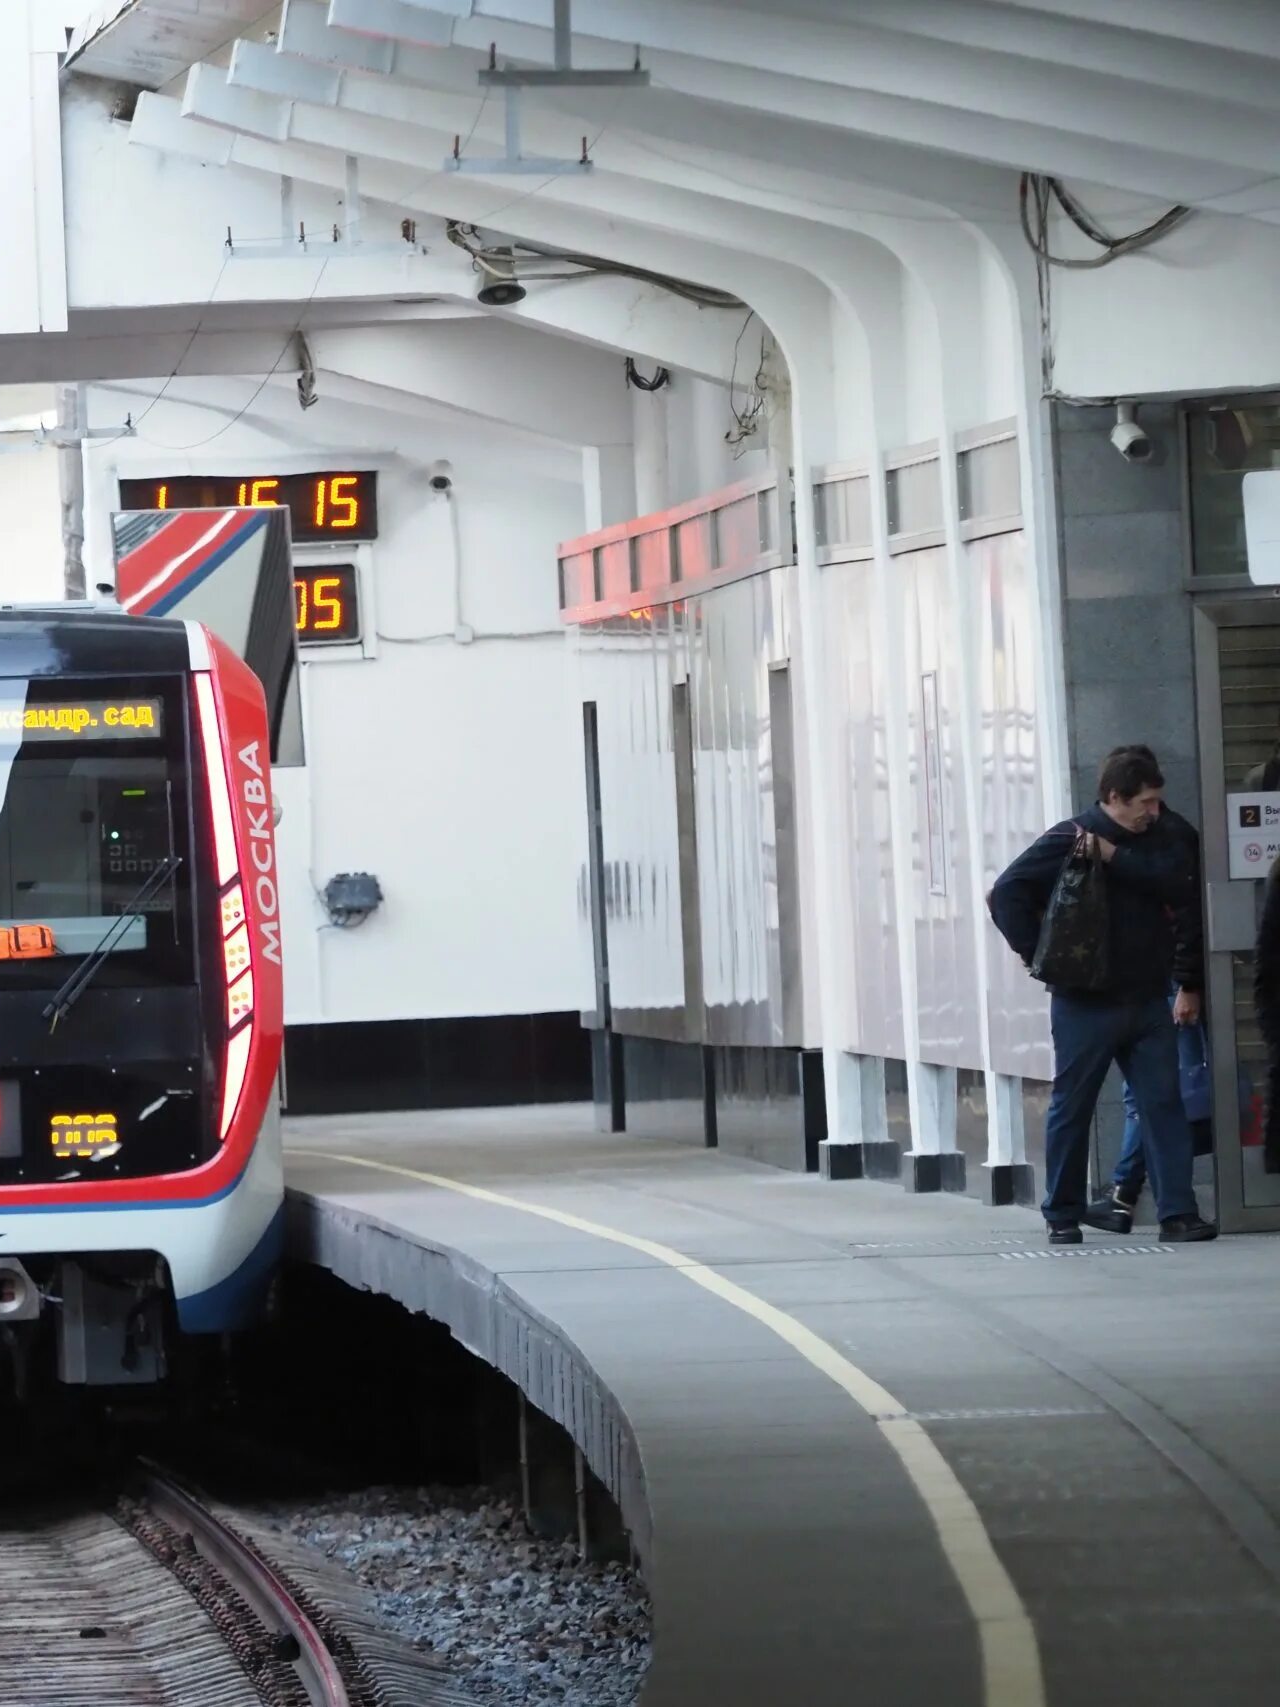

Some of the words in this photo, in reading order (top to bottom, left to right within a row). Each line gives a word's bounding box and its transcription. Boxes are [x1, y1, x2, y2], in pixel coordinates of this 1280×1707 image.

[316, 477, 358, 527] 15
[103, 706, 154, 728] сад
[238, 740, 282, 966] МОСКВА
